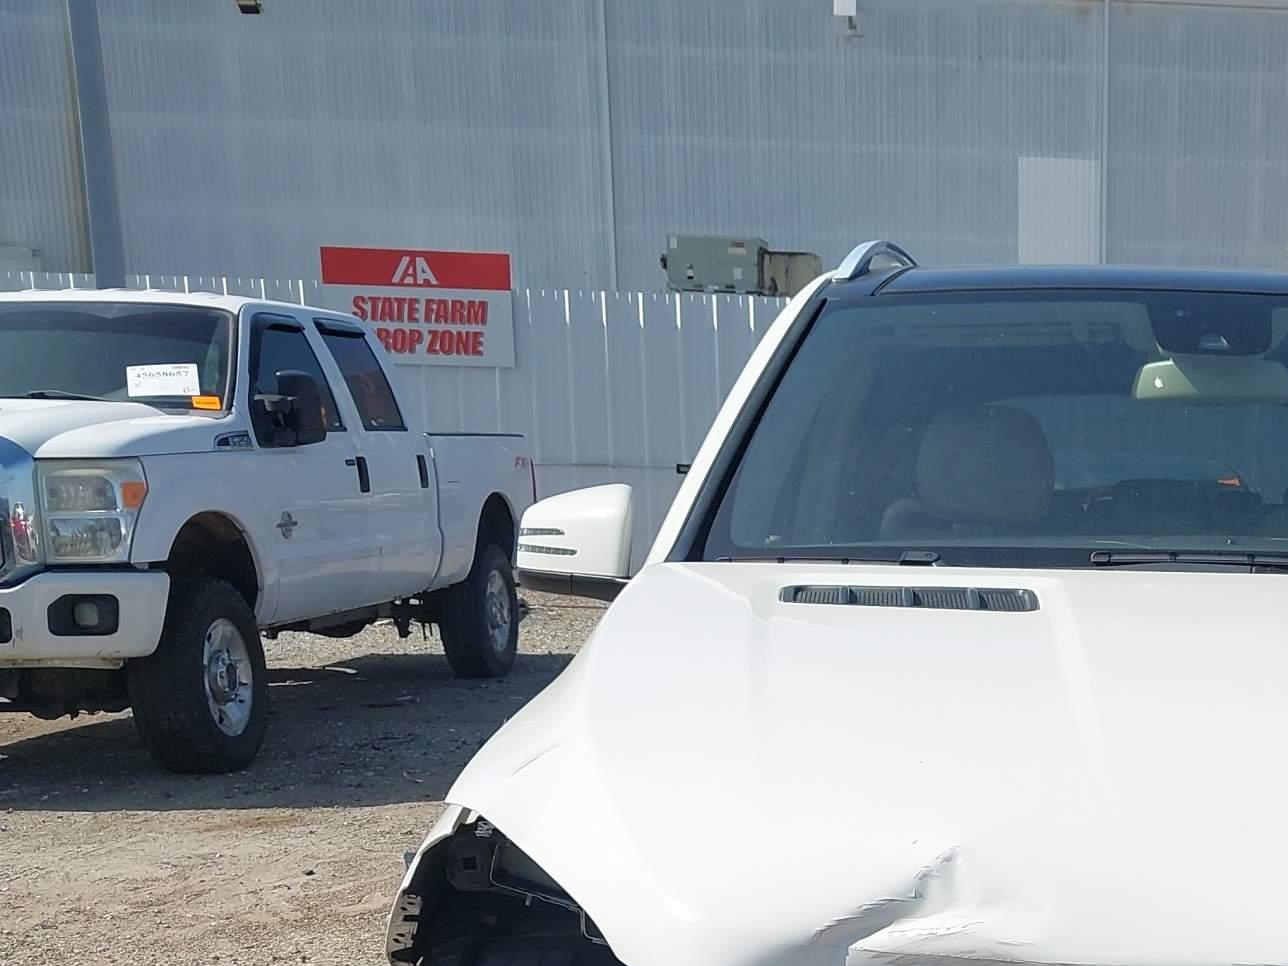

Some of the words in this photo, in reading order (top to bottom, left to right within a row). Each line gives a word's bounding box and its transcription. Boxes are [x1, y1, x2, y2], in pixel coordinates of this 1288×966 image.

[352, 295, 420, 323] STATE
[424, 298, 488, 325] FARM
[373, 328, 424, 354] ROP
[426, 330, 484, 356] ZONE
